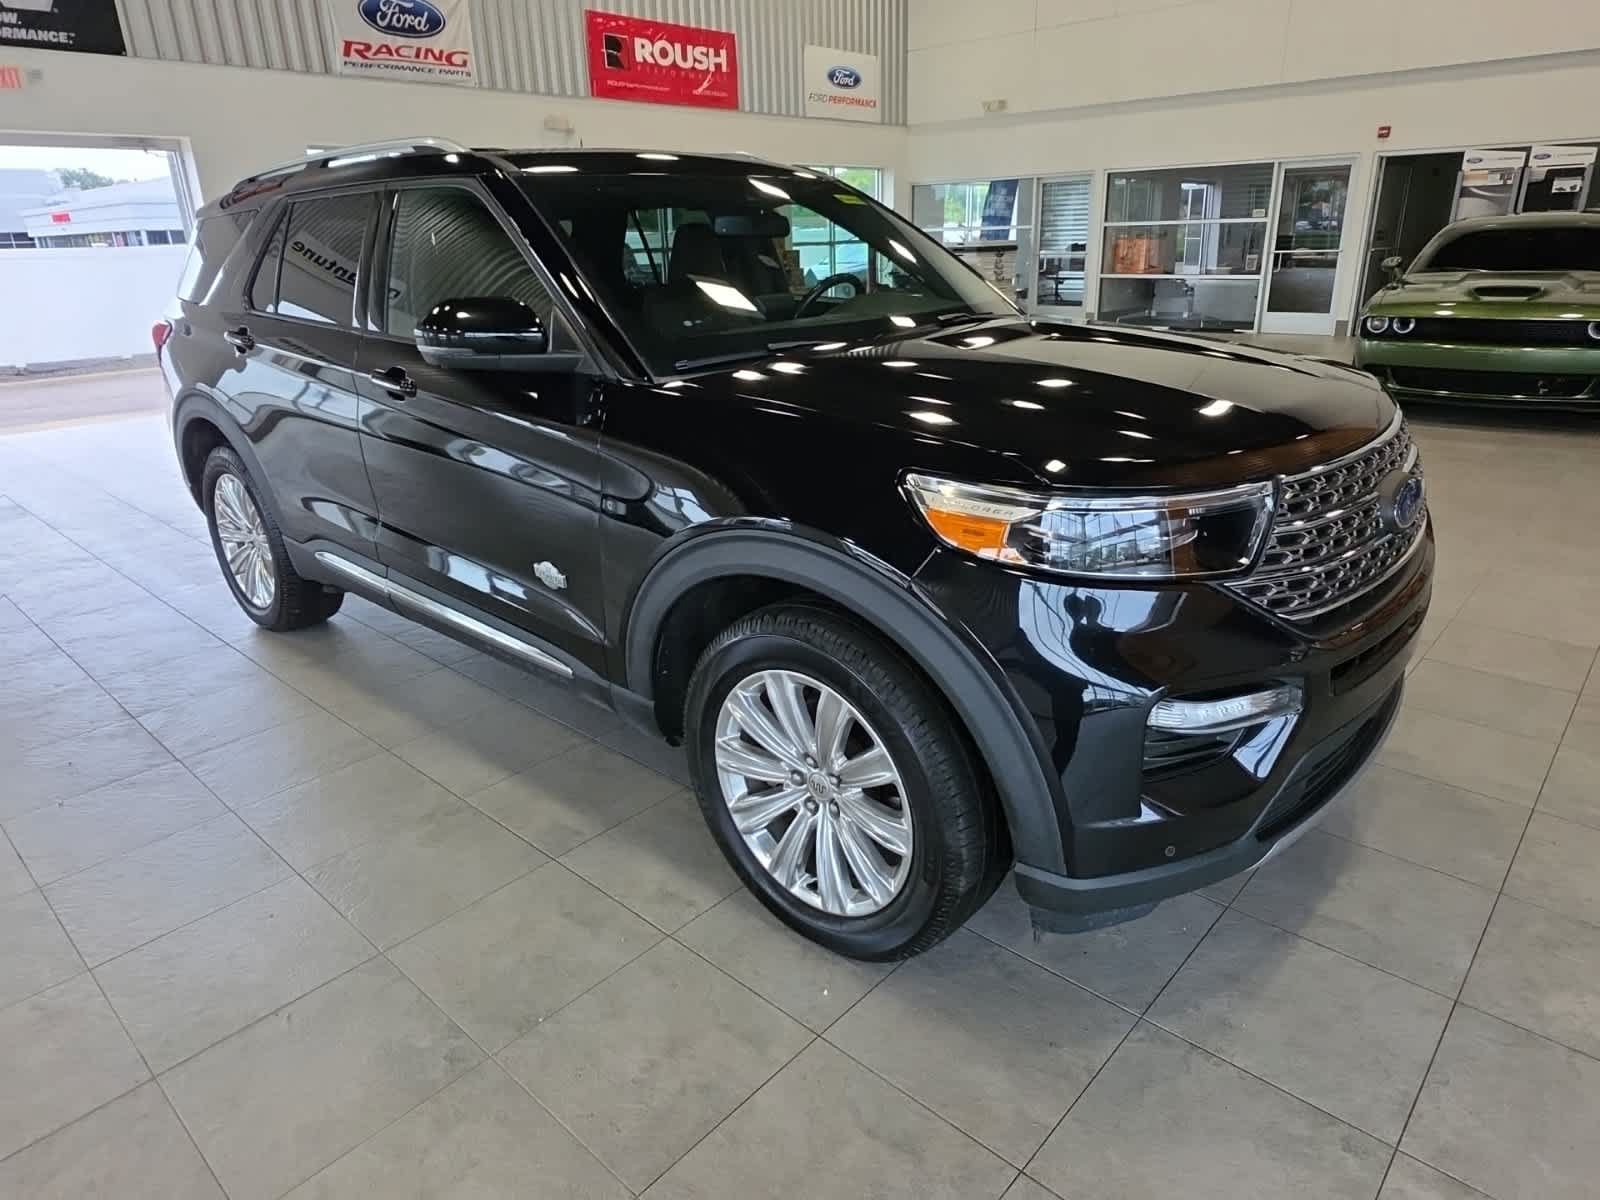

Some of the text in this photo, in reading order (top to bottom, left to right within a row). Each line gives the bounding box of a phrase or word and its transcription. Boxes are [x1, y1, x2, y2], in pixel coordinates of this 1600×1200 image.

[0, 11, 22, 25] W.
[376, 0, 430, 32] Ford
[0, 26, 75, 44] RMANCE.
[342, 40, 469, 68] RACING
[633, 36, 728, 73] ROUSH
[343, 60, 472, 78] PERFORMANCE PARTS
[833, 69, 856, 86] Ford
